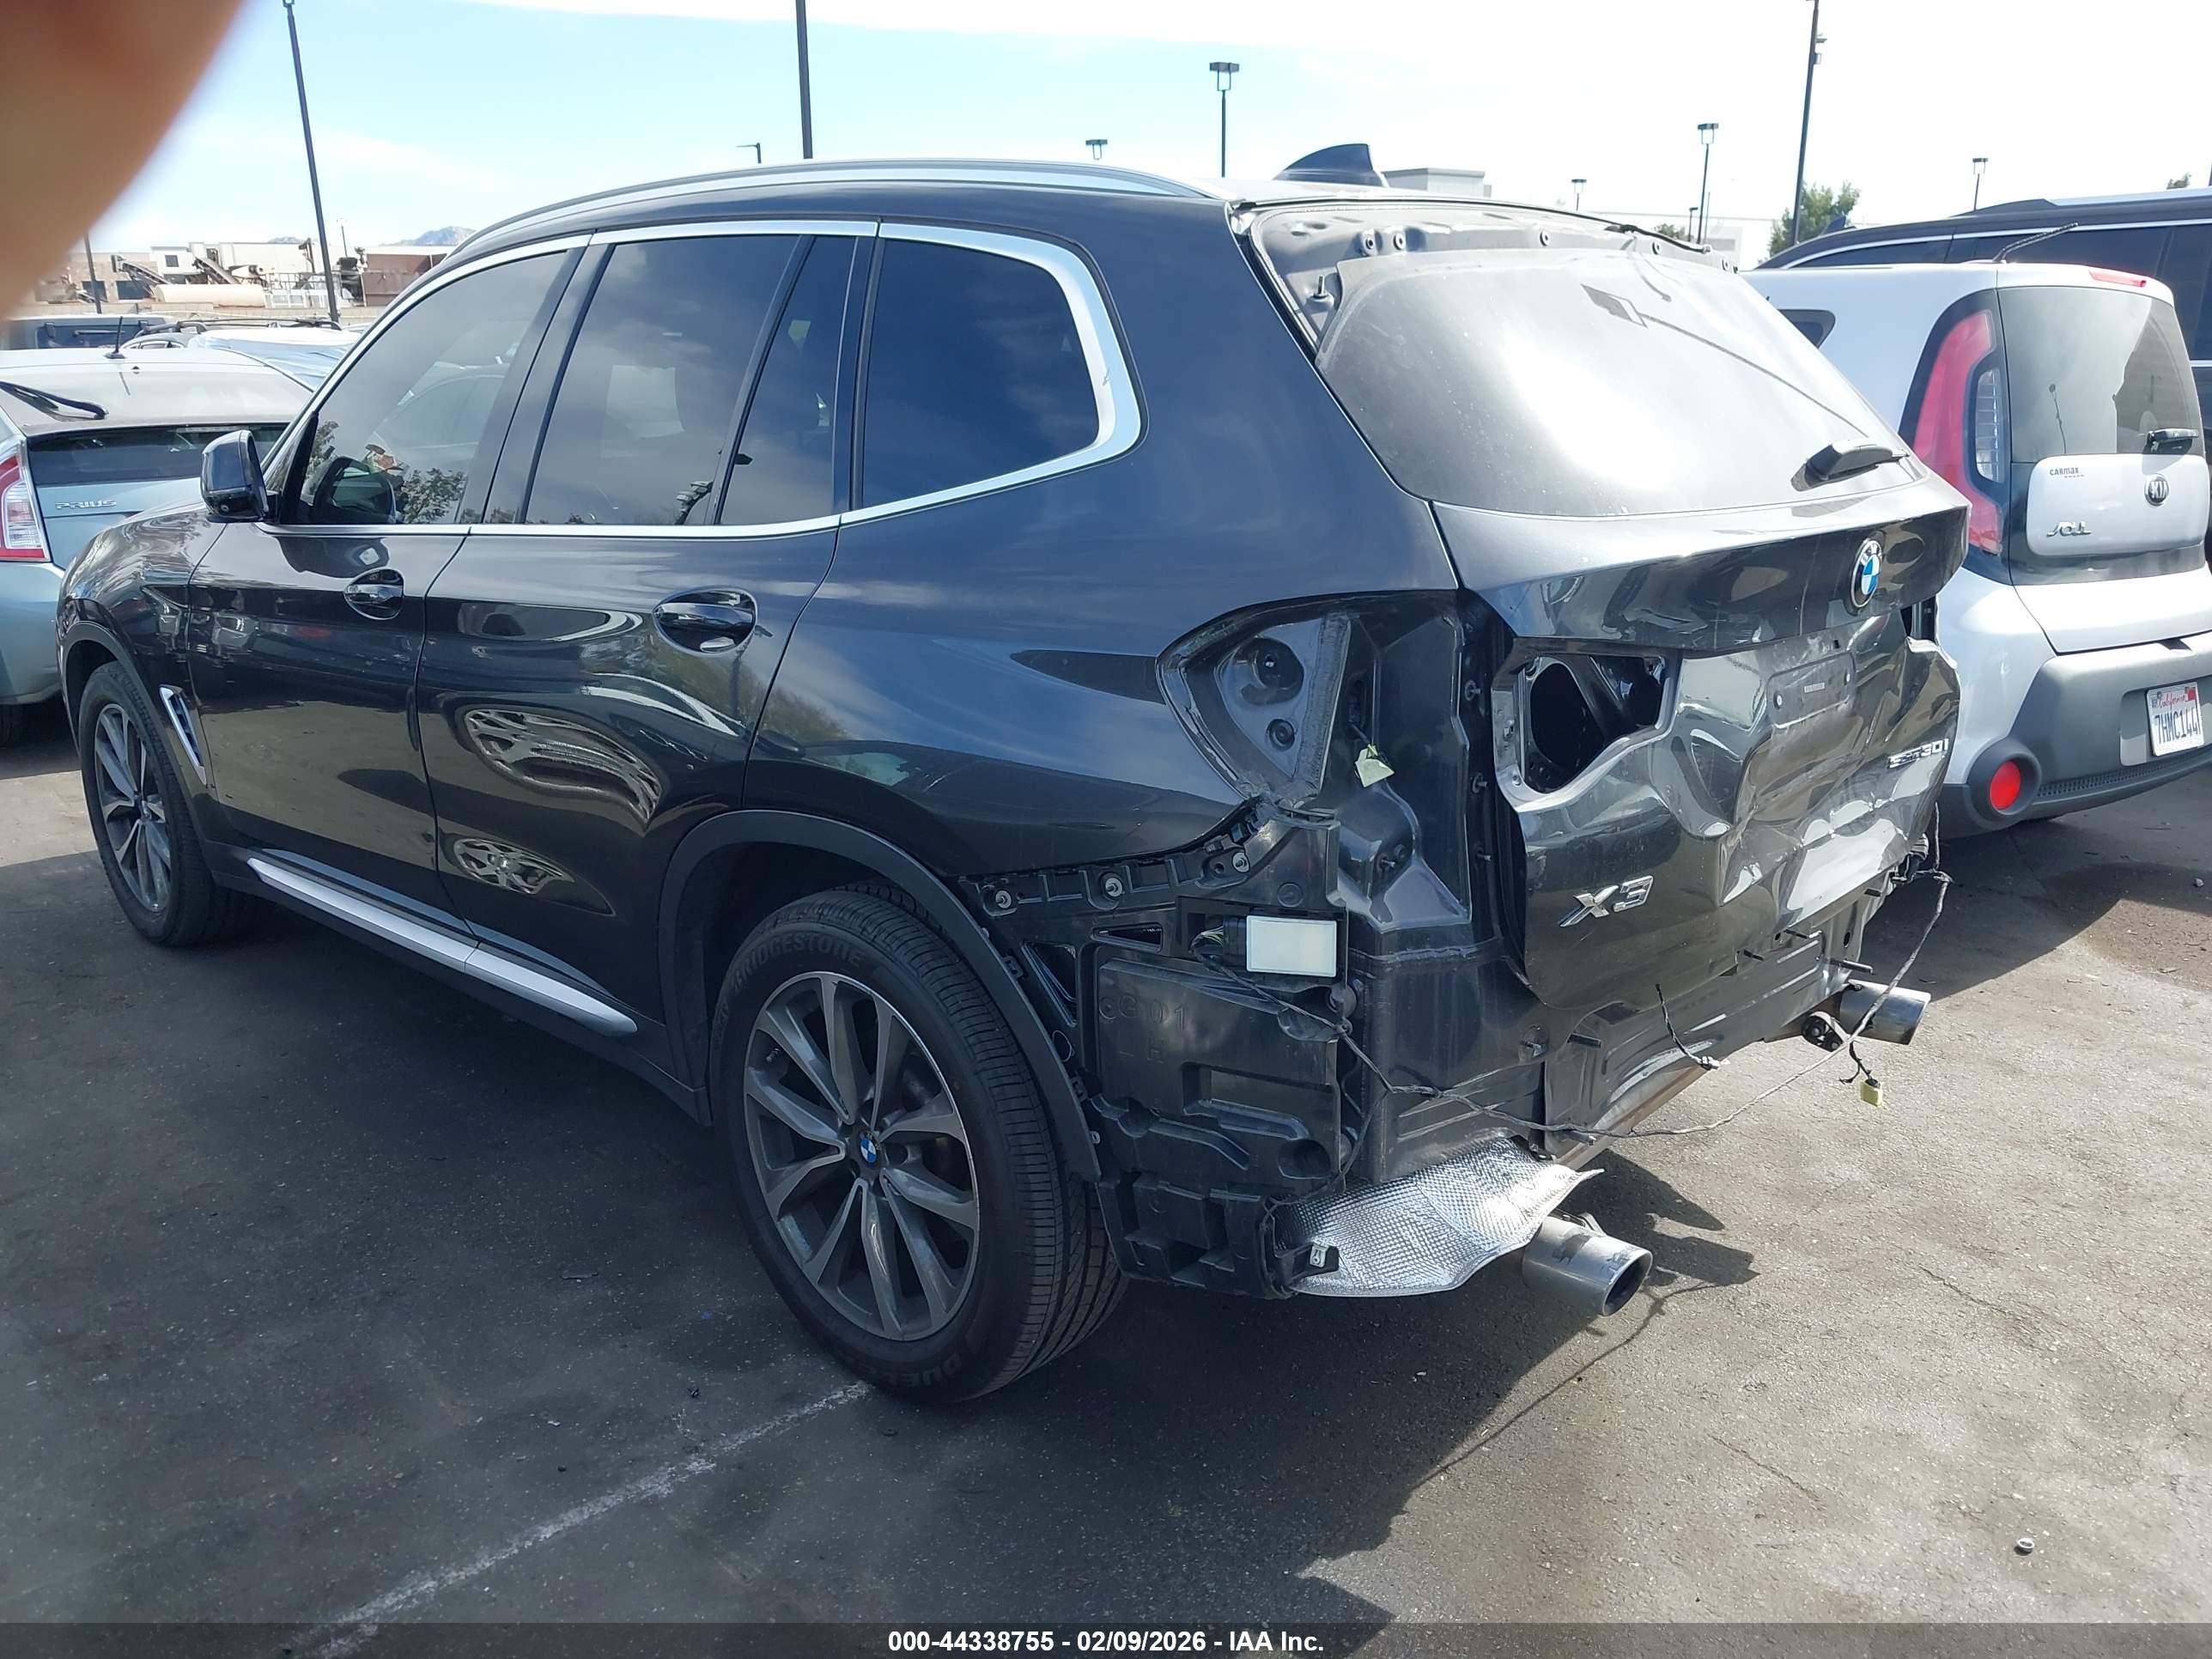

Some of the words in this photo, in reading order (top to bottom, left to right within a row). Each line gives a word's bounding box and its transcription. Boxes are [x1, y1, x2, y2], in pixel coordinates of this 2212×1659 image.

[55, 500, 117, 509] PRIUS
[2154, 708, 2201, 744] 7HMC144
[1559, 875, 1654, 927] X3
[732, 933, 866, 994] BRIDGESTONE
